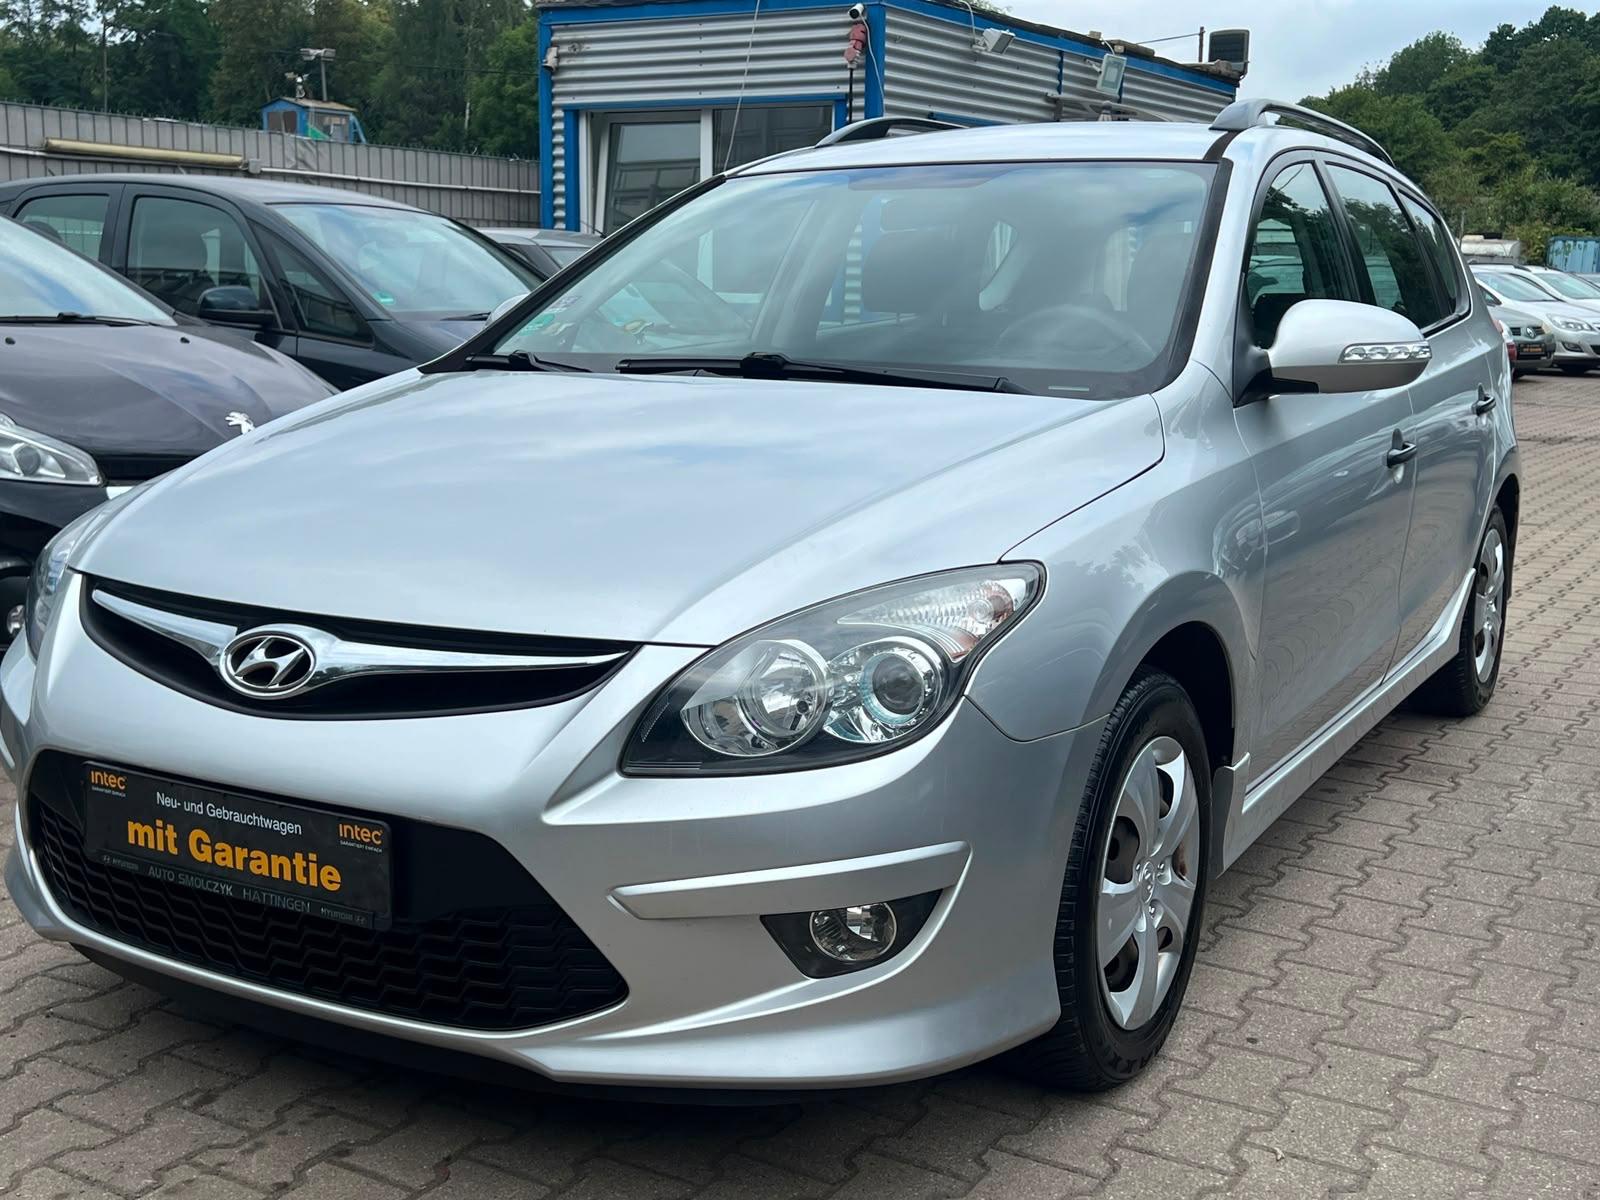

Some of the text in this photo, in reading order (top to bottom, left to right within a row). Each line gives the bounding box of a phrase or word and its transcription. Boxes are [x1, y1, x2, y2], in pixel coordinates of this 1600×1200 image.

[91, 770, 126, 790] intec
[156, 791, 302, 836] Neu- und Gebrauchtwagen
[339, 823, 383, 845] intec
[127, 819, 342, 892] mit Garantie
[148, 865, 311, 913] AUTO SMOLCZYK HATTINGEN
